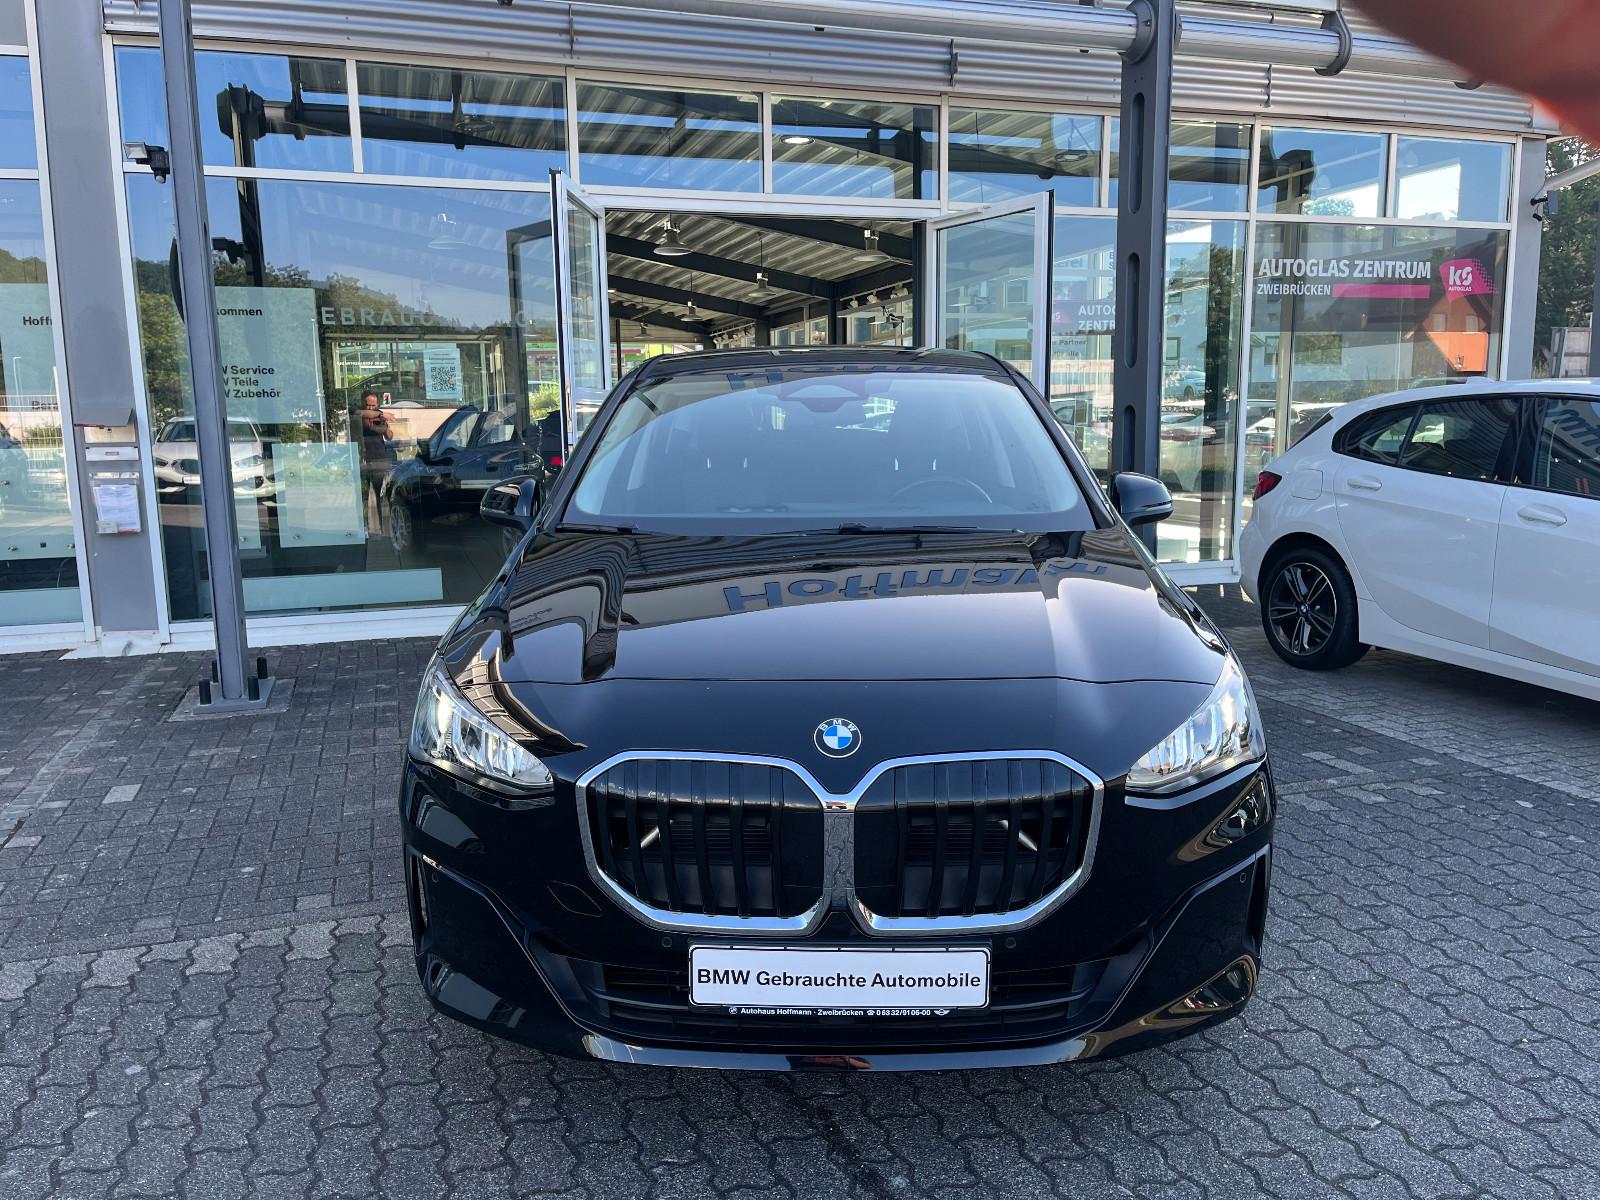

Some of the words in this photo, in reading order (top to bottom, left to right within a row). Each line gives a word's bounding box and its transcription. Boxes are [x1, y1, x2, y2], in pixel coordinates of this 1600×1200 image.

[1258, 258, 1350, 278] AUTOGLAS
[1353, 260, 1431, 279] ZENTRUM
[1256, 281, 1331, 296] ZWEIBRÜCKEN
[22, 316, 53, 326] Hoff
[1078, 320, 1116, 331] ZENTR
[230, 365, 275, 375] Service
[232, 377, 259, 386] Teile
[233, 388, 281, 398] Zubehör
[819, 719, 857, 732] BMW
[697, 968, 750, 985] BMW
[756, 970, 867, 987] Gebrauchte
[870, 972, 981, 988] Automobile
[740, 1007, 776, 1015] Autohaus
[776, 1008, 812, 1016] Hoffmann
